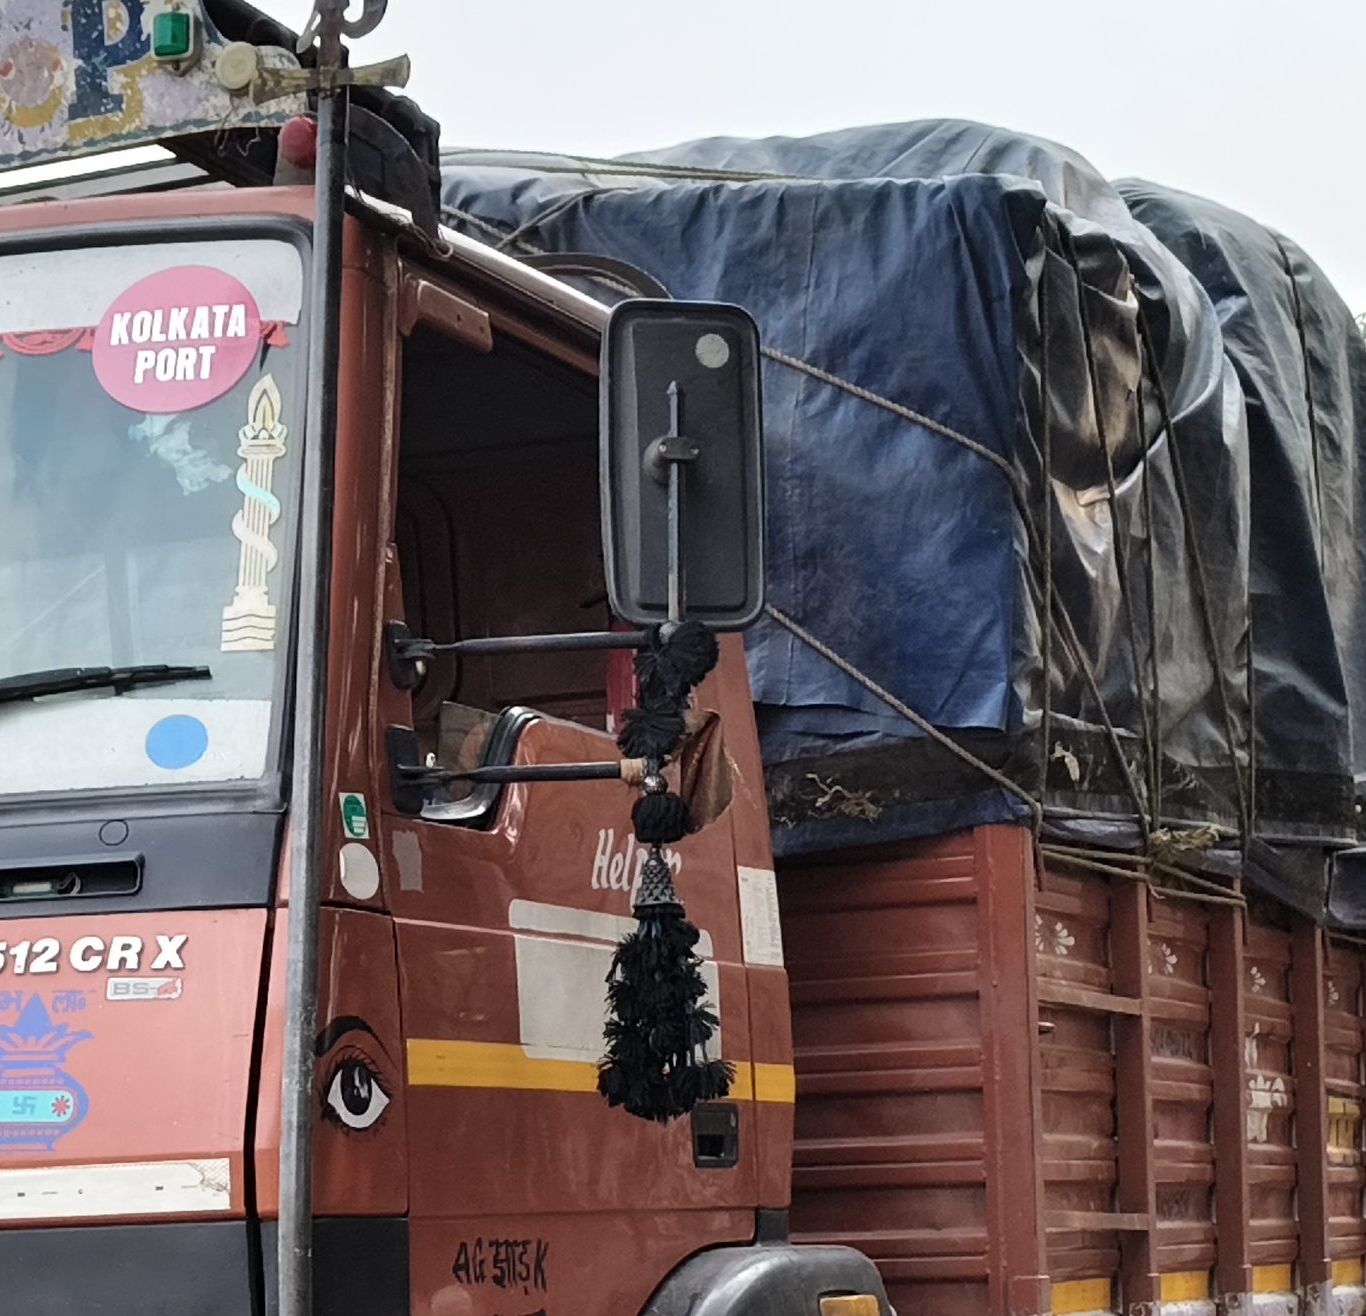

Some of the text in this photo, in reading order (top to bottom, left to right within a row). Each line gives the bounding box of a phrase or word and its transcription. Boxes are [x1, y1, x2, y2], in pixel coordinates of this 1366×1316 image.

[110, 303, 247, 346] KOLKATA
[133, 345, 216, 384] PORT
[590, 827, 683, 915] Helpr
